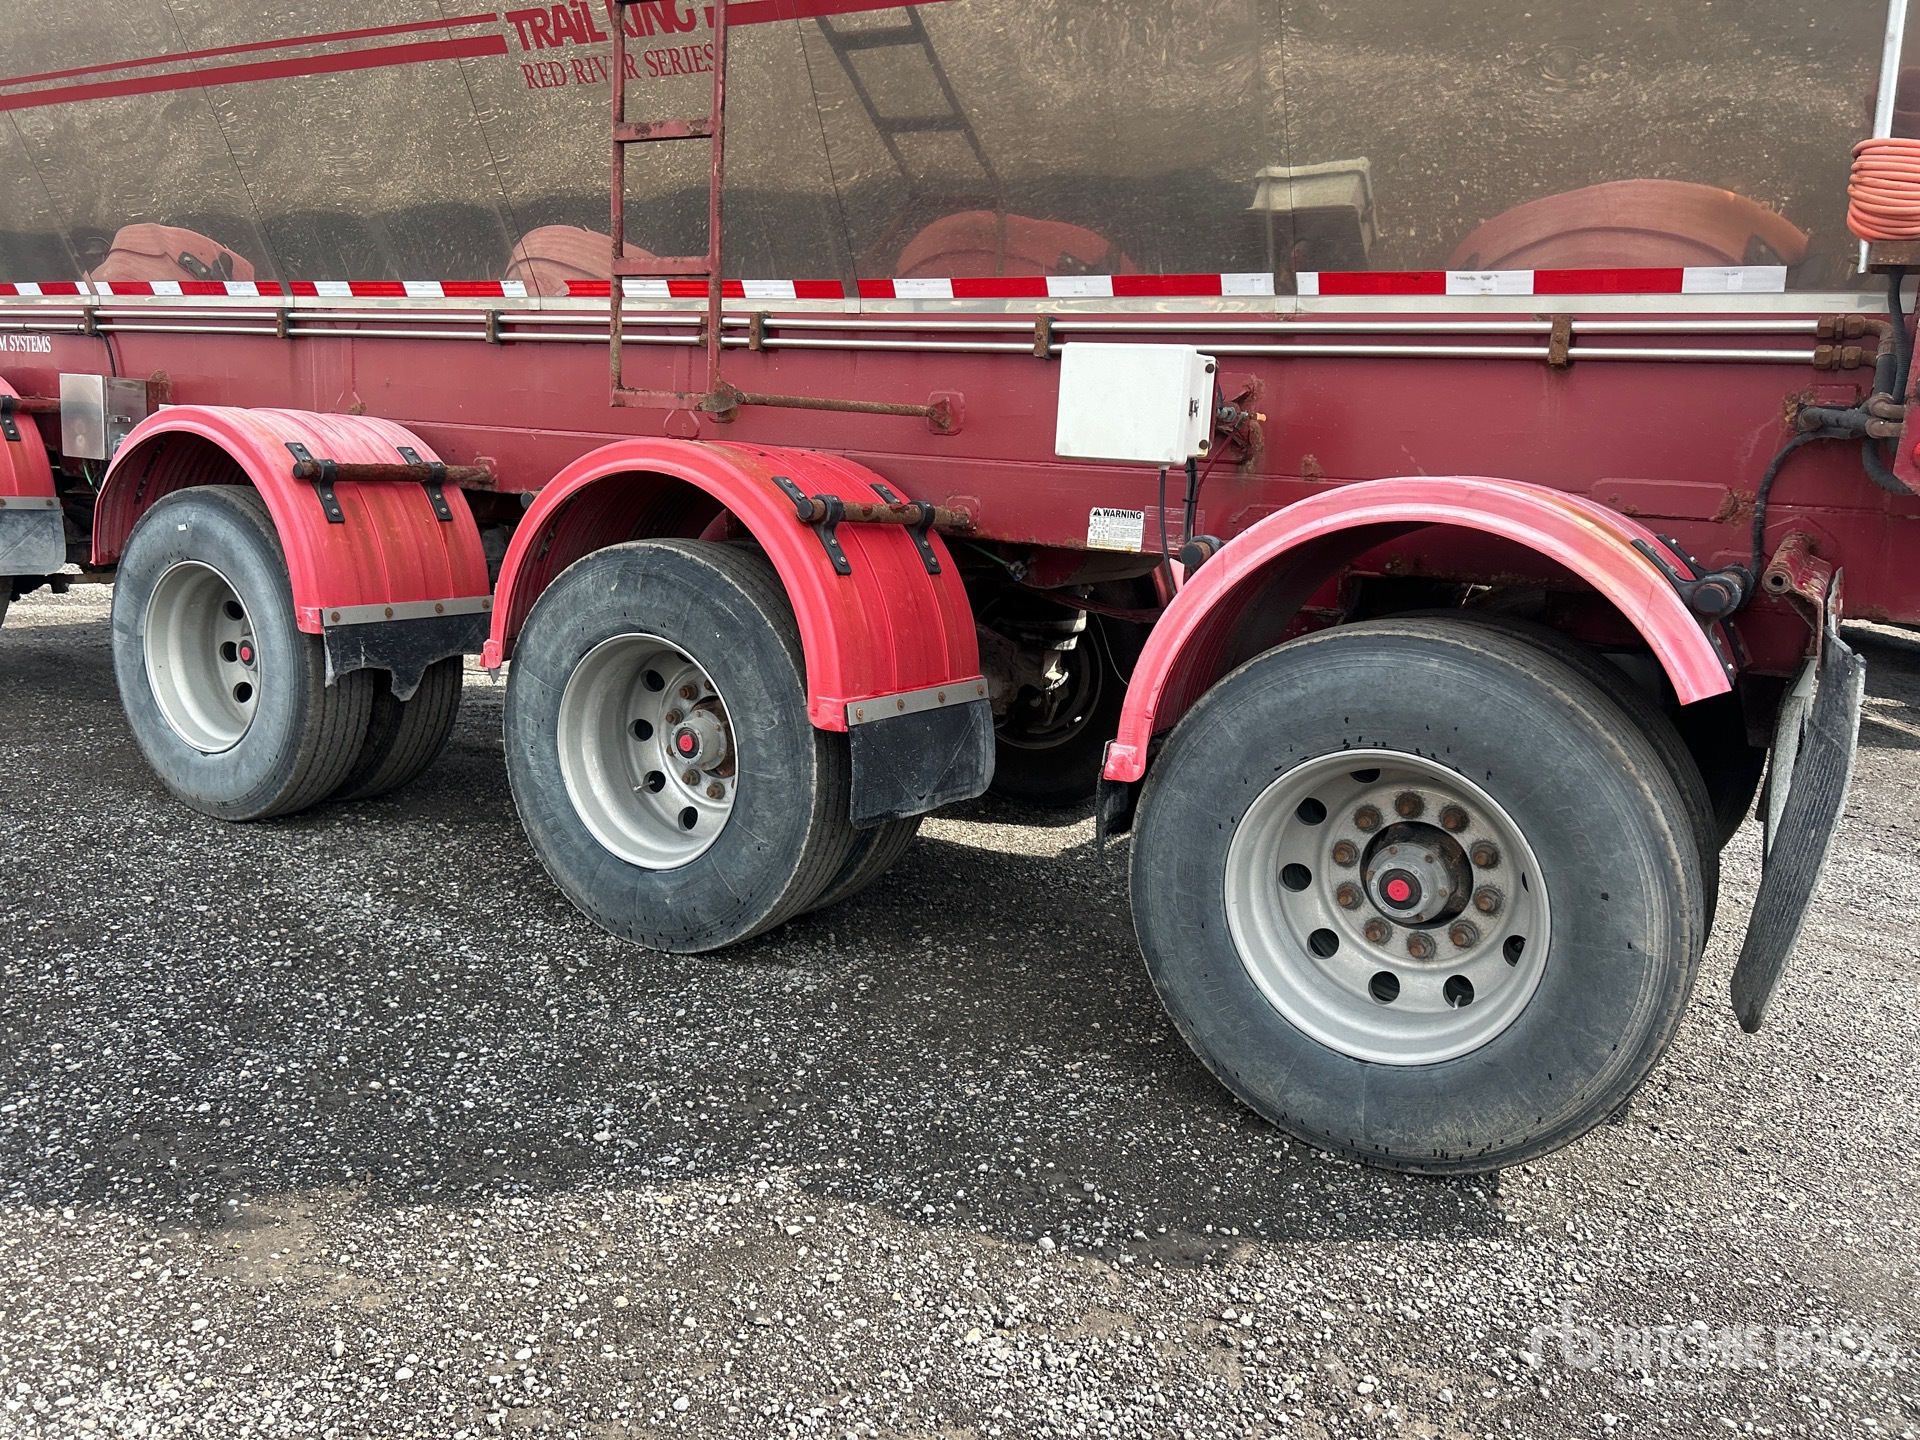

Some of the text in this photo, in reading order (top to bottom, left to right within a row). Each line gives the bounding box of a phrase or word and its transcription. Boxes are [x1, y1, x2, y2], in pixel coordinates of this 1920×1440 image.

[521, 43, 714, 89] RED RIVR SERIES
[9, 335, 52, 353] SYSTEMS
[1103, 509, 1142, 520] WARNING
